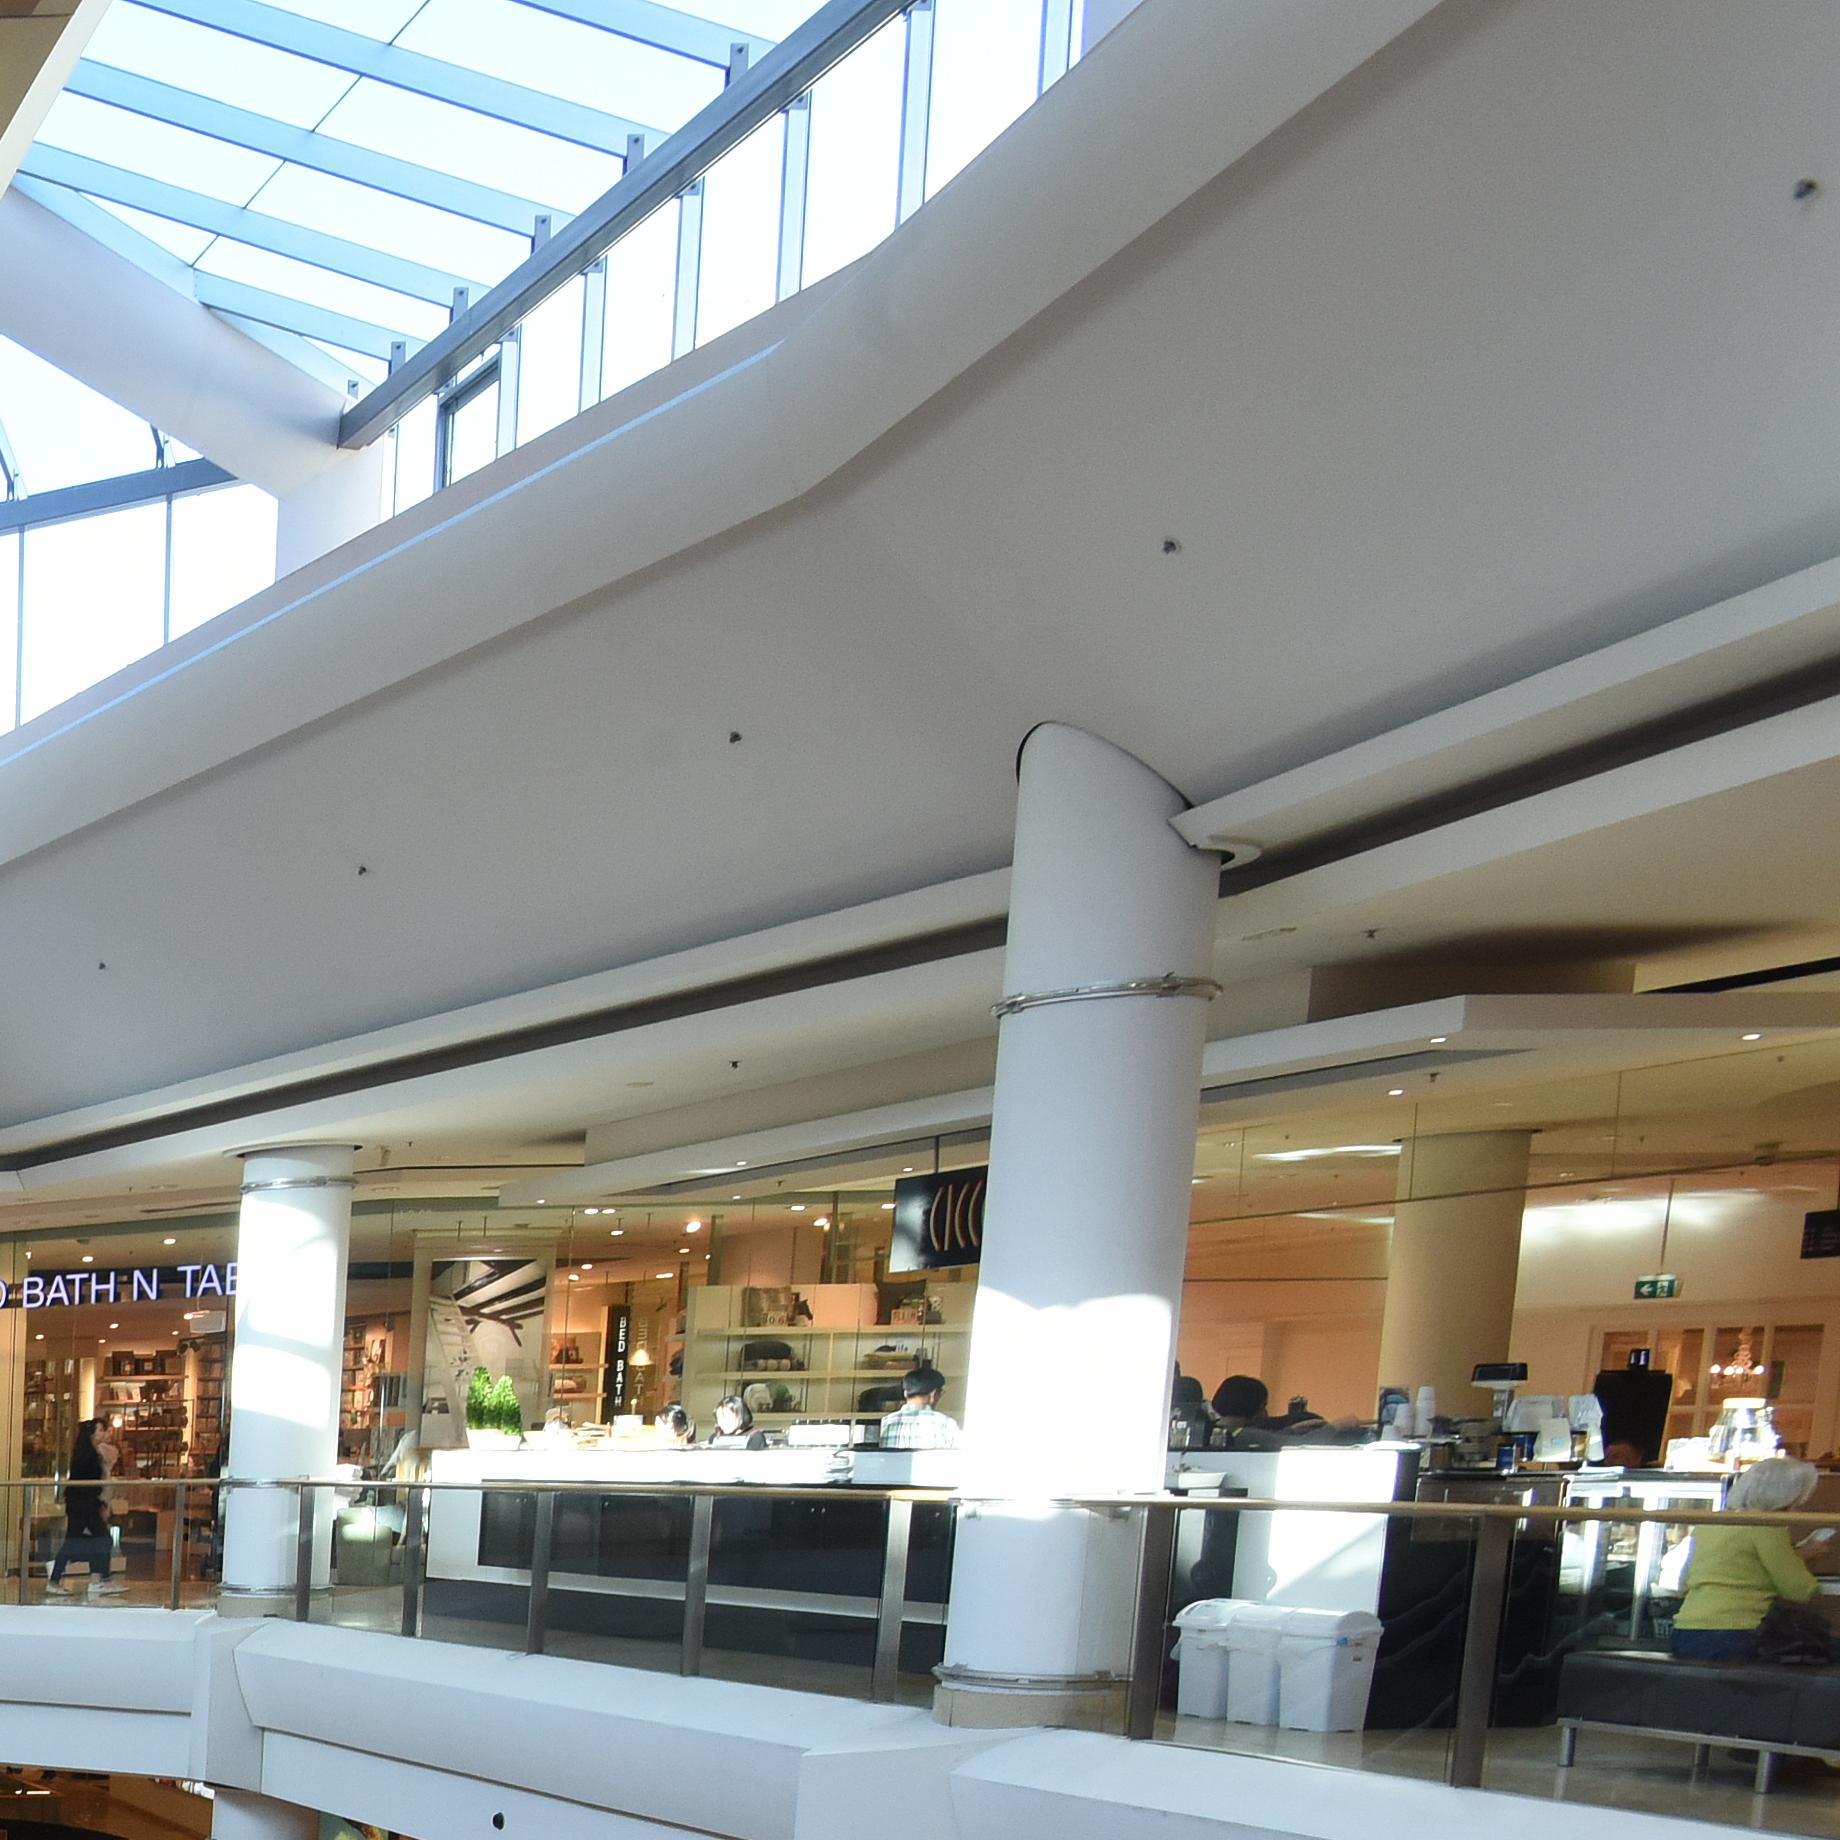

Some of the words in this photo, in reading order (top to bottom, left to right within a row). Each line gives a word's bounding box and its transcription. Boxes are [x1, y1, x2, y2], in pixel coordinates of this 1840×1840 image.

[22, 1271, 114, 1309] BATH
[133, 1268, 158, 1301] N
[617, 1316, 627, 1352] BED
[614, 1359, 625, 1407] BATH
